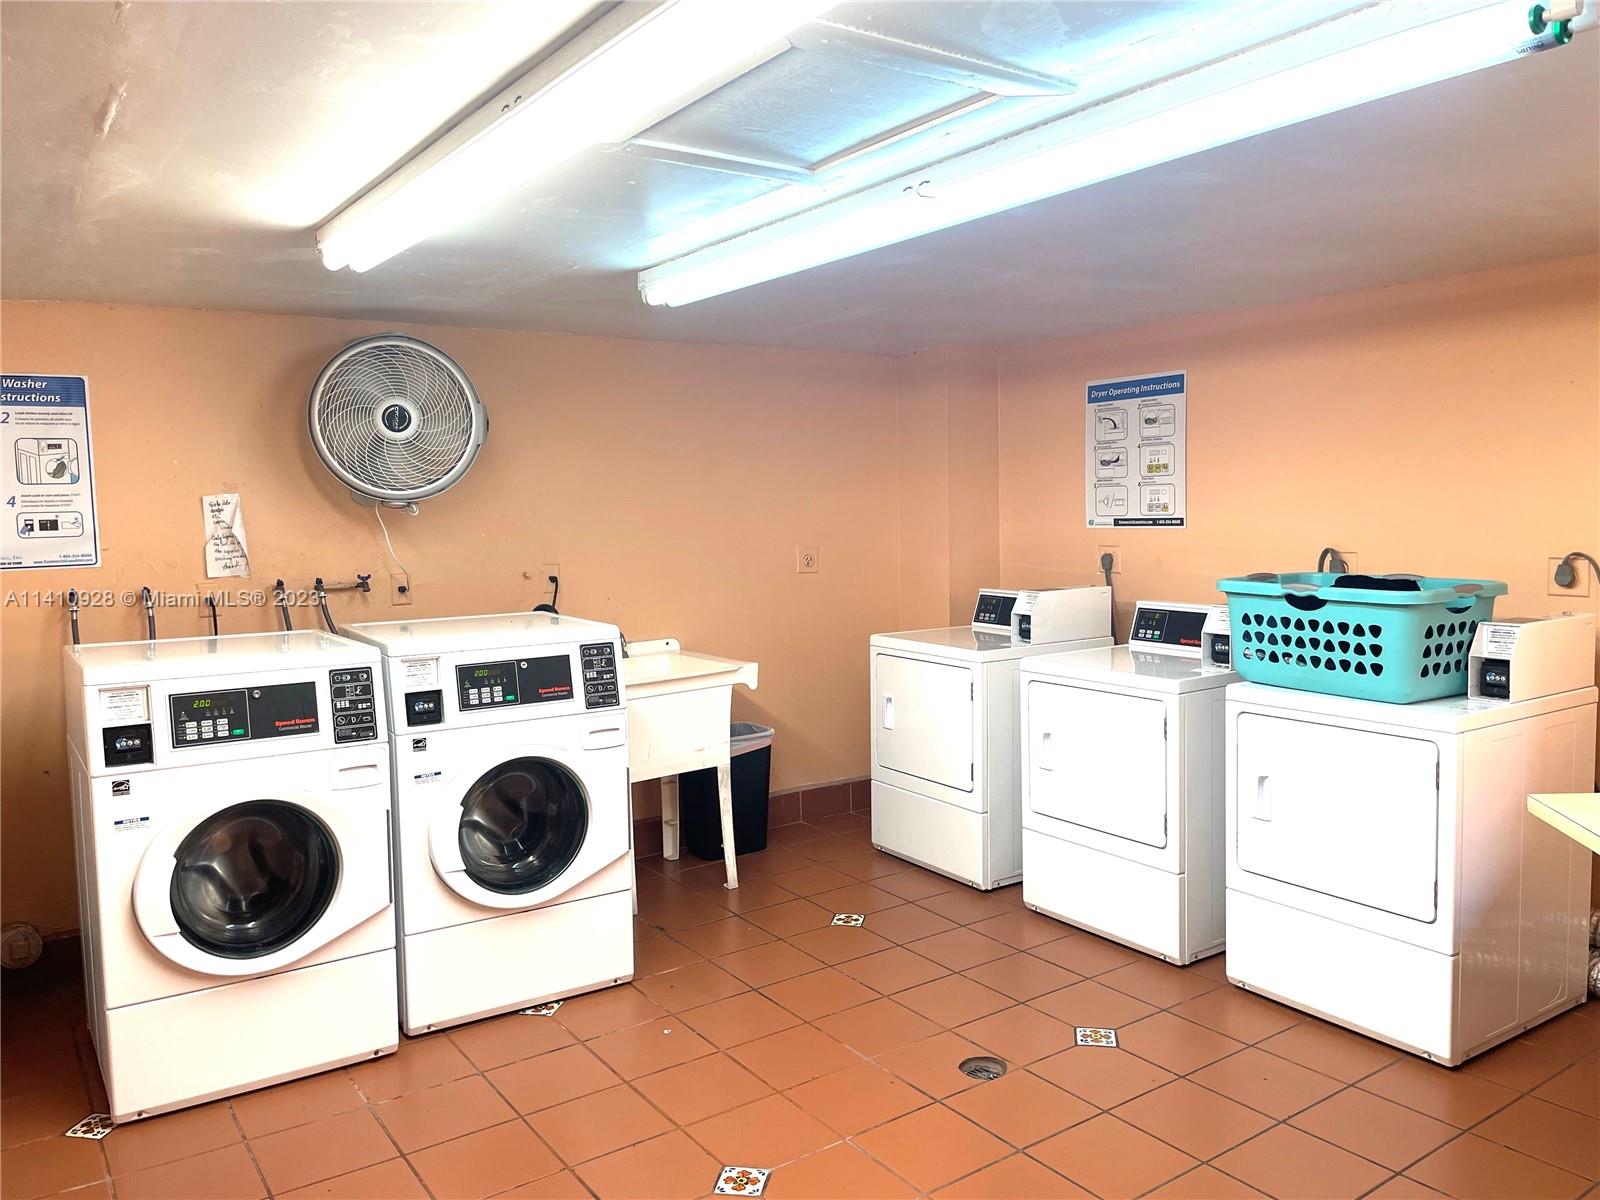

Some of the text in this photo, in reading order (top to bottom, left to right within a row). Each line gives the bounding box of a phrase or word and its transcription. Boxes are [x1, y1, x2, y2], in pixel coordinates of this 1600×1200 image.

[2, 378, 48, 389] Washer
[1091, 381, 1181, 398] Dryer Operating Instructions
[0, 393, 61, 402] structions
[0, 412, 10, 423] 2
[6, 495, 17, 508] 4
[193, 699, 211, 708] 2.00
